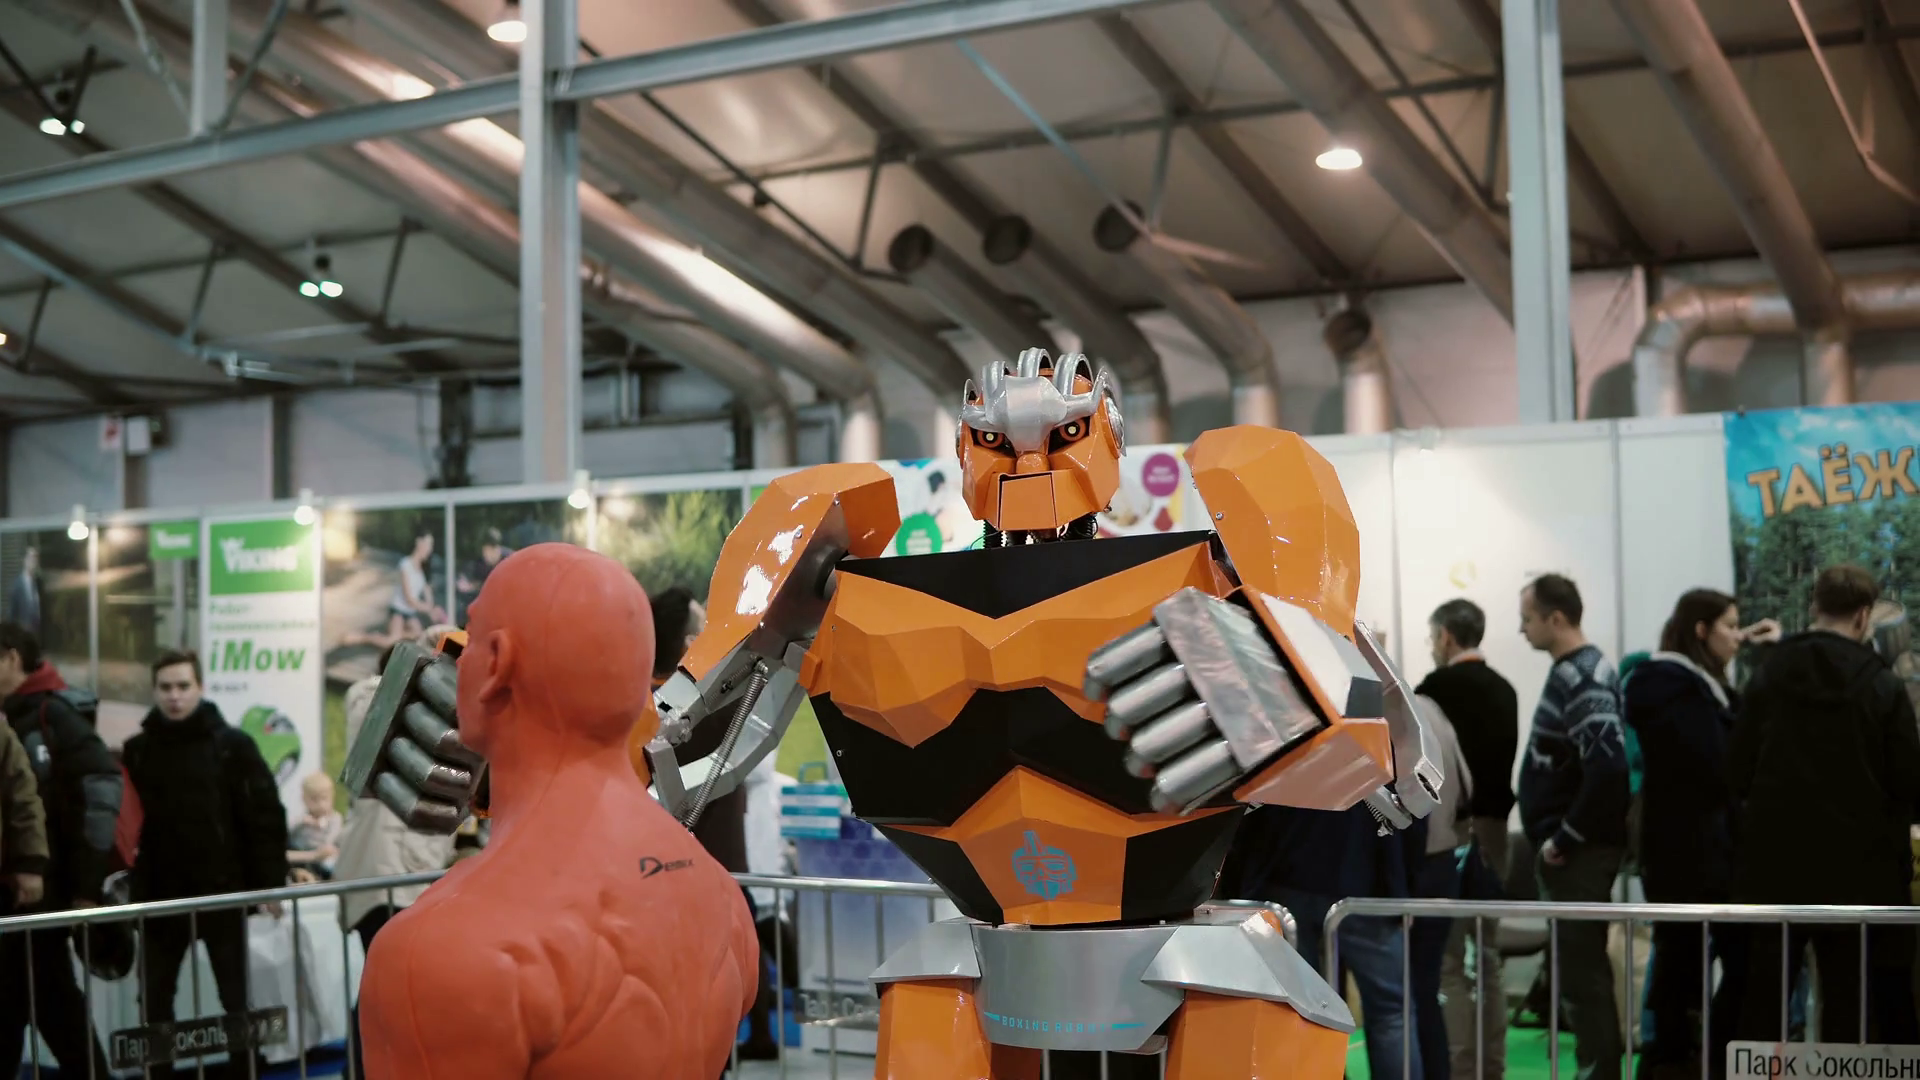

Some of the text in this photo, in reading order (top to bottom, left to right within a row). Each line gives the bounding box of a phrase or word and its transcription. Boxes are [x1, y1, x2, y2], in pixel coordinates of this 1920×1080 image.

[1746, 441, 1920, 518] ТАЁЖ
[210, 638, 306, 672] iMow
[1002, 1015, 1049, 1032] BOXING
[1735, 1048, 1920, 1080] Парк Сокольн
